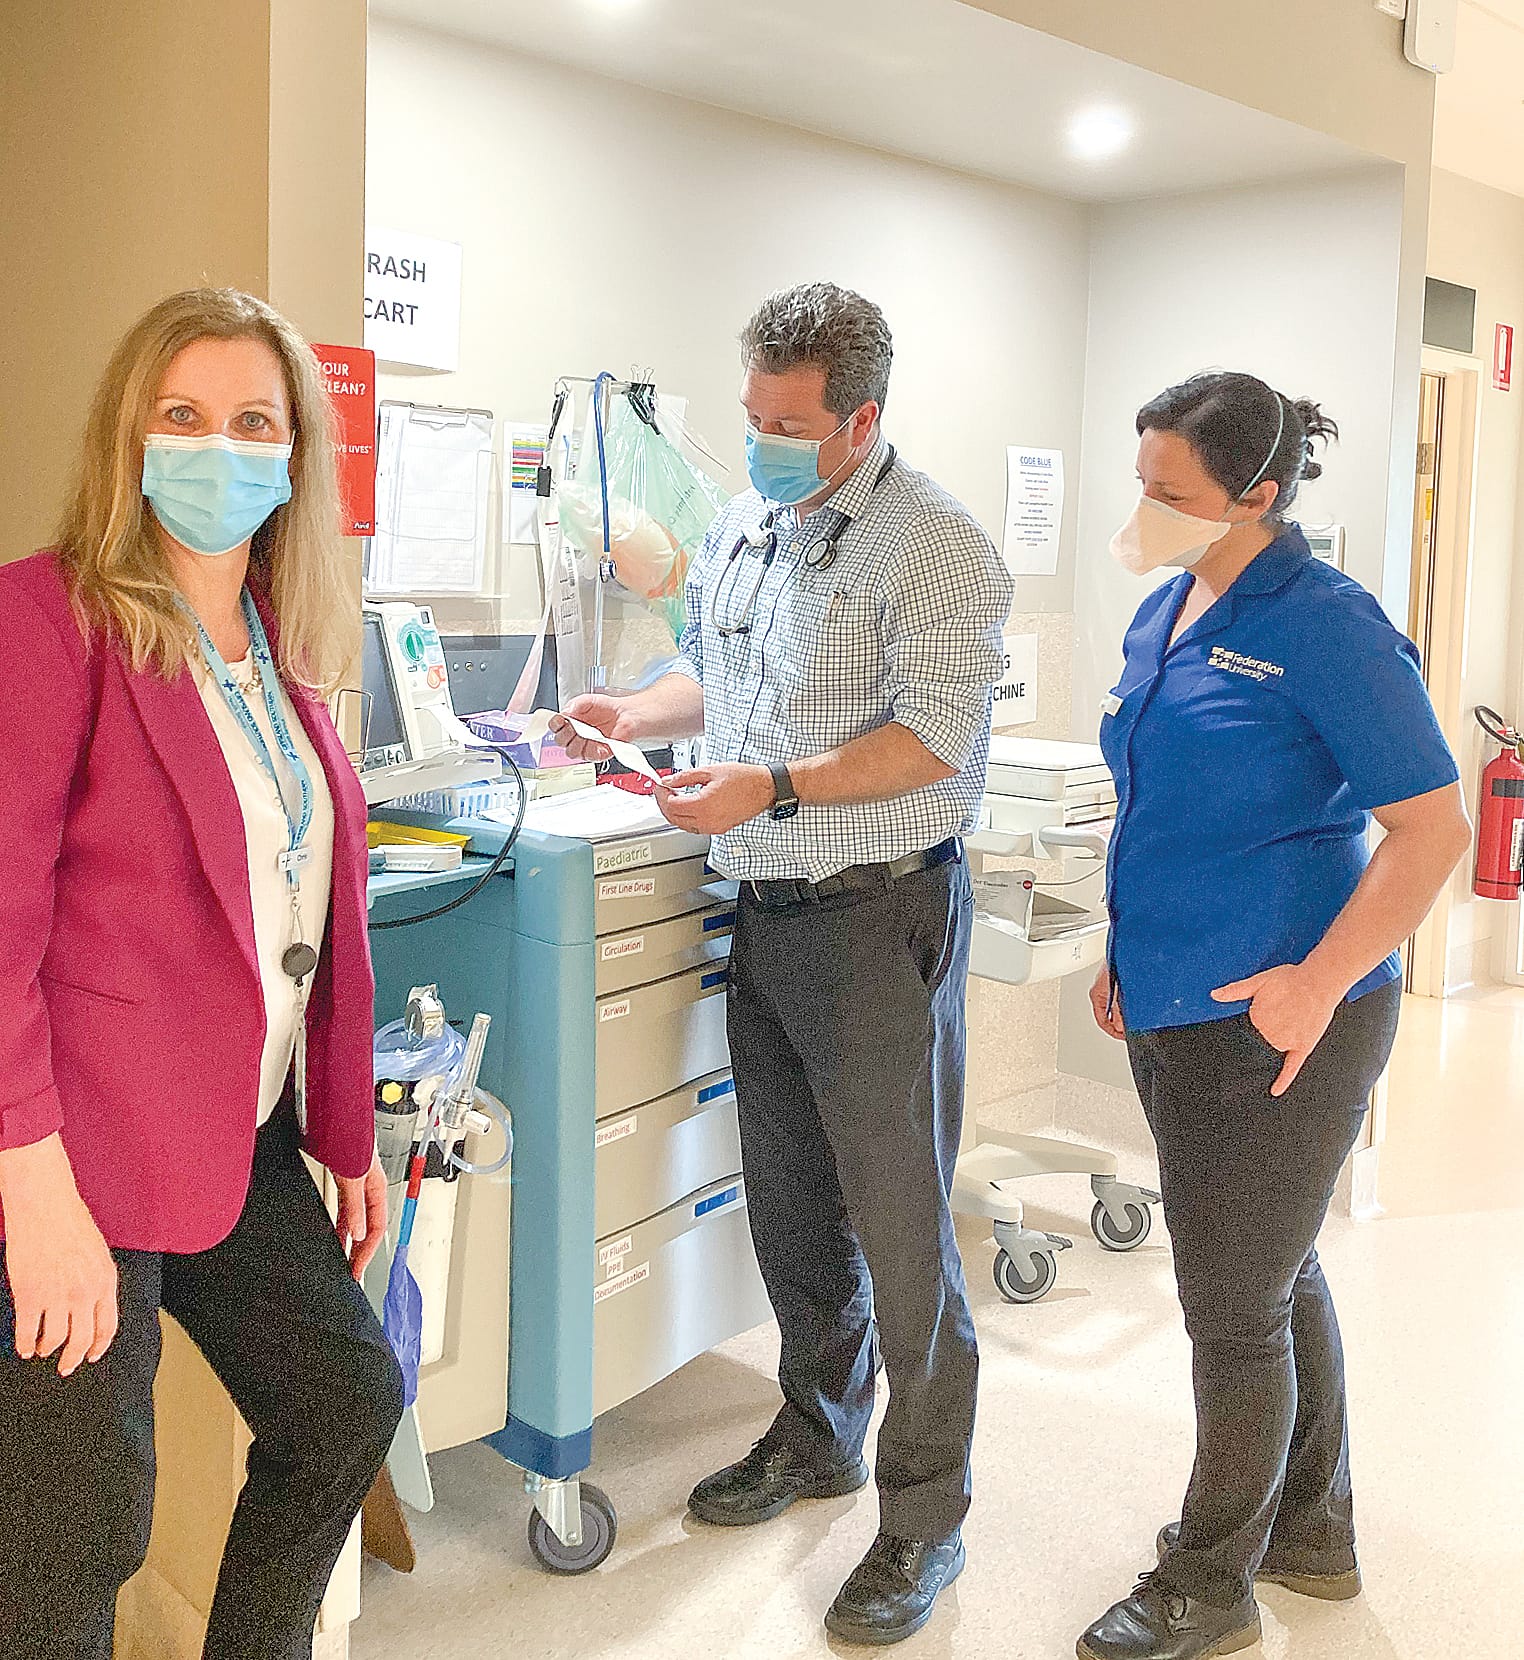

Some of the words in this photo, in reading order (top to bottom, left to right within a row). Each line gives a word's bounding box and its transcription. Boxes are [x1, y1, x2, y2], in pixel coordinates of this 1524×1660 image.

[367, 252, 426, 283] RASH
[364, 297, 419, 325] CART
[1019, 456, 1036, 466] CODE
[1037, 457, 1052, 468] BLUE
[1003, 654, 1011, 669] G
[1232, 652, 1285, 677] Federation
[1228, 663, 1268, 682] University
[992, 682, 1026, 702] CHINE
[596, 847, 649, 870] Paediatric
[601, 885, 617, 896] First
[618, 884, 633, 894] Line
[633, 881, 654, 893] Drugs
[604, 941, 641, 957] Circulation
[602, 1005, 629, 1018] Airway
[596, 1124, 631, 1145] Breathing
[609, 1241, 631, 1258] Fluids
[607, 1261, 622, 1276] PPE
[594, 1268, 647, 1301] Documentation
